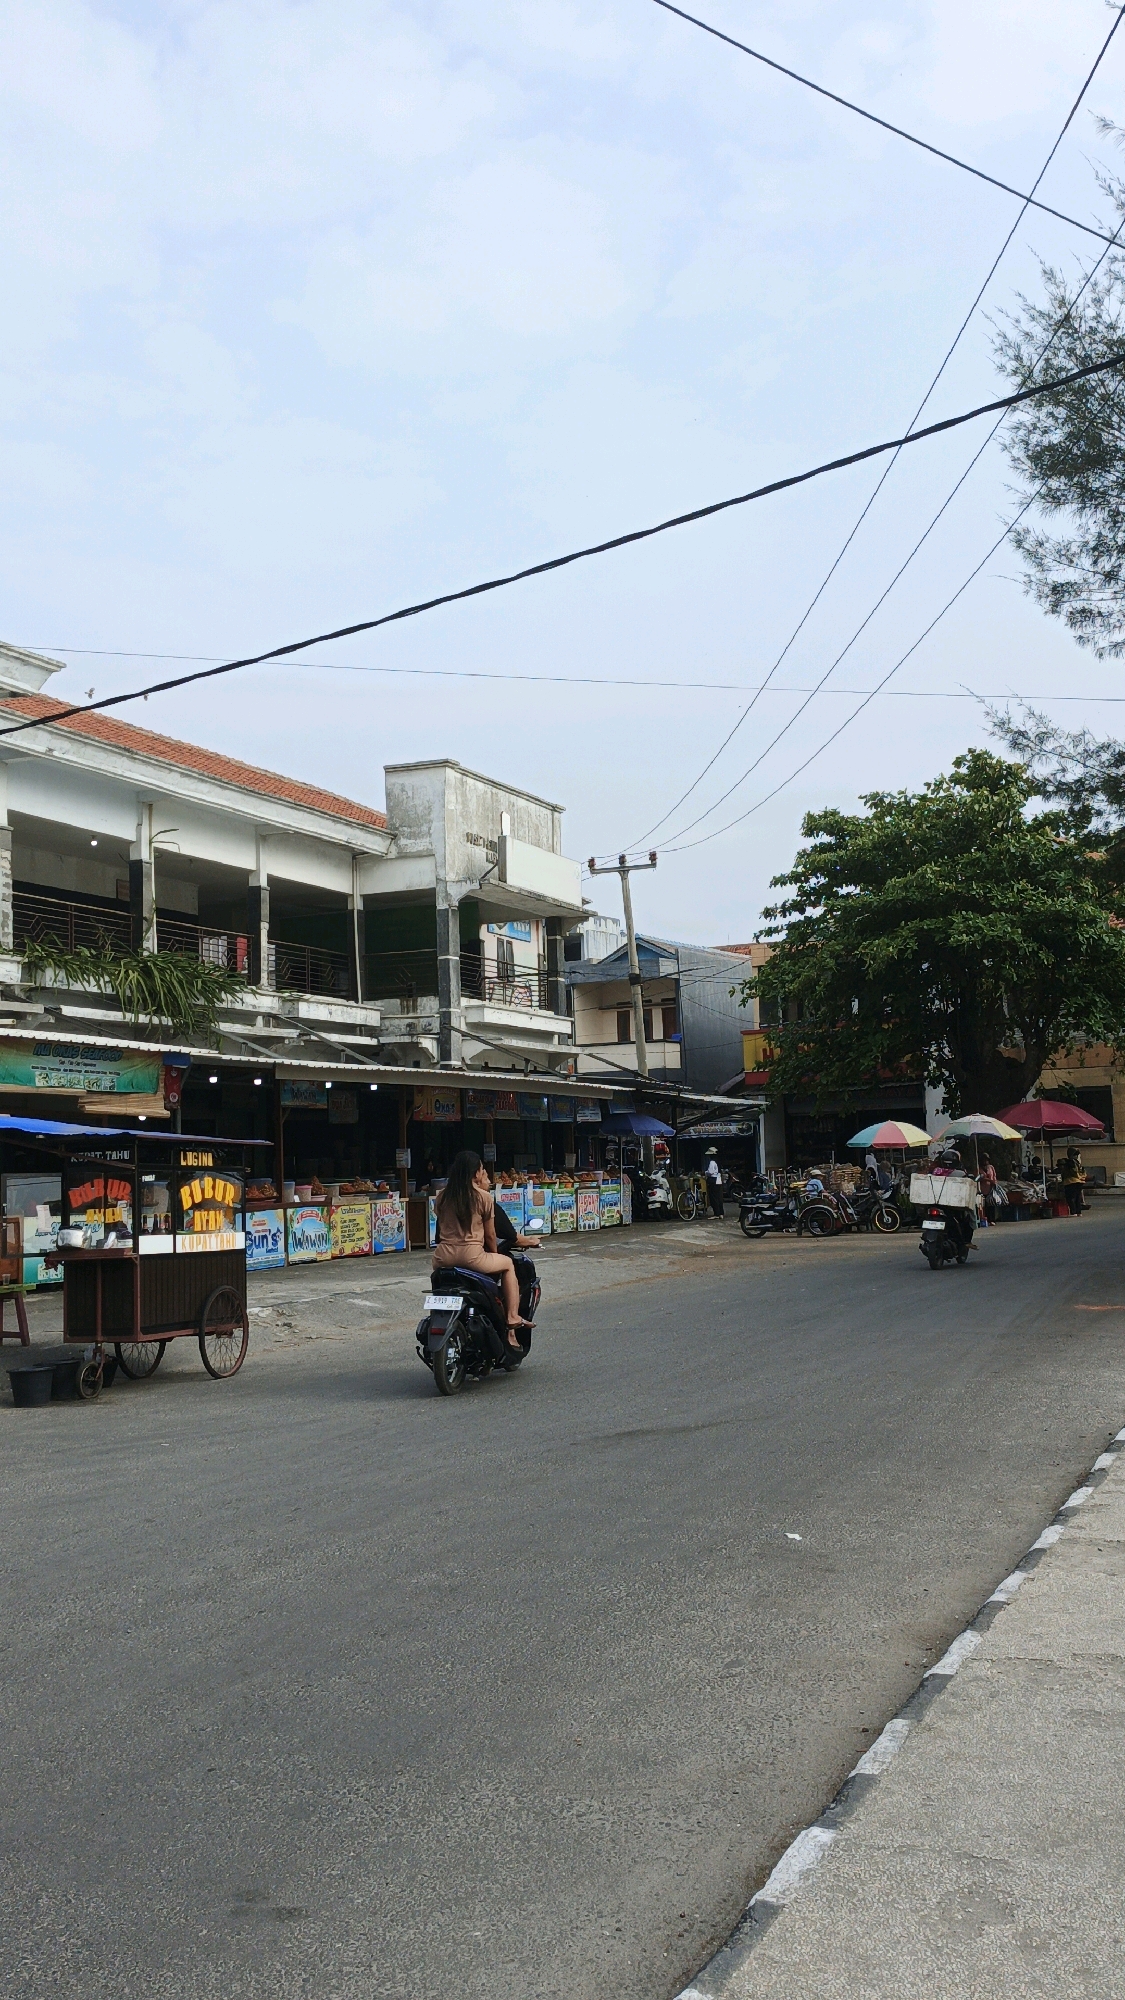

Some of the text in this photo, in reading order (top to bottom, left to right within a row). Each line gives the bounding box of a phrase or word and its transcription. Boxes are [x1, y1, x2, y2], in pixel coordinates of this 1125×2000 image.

[80, 1047, 123, 1062] SEAFOOD
[105, 1150, 130, 1161] TAHU
[180, 1176, 235, 1211] BUBUR
[194, 1210, 224, 1232] AYAM
[181, 1234, 212, 1251] KUPAT
